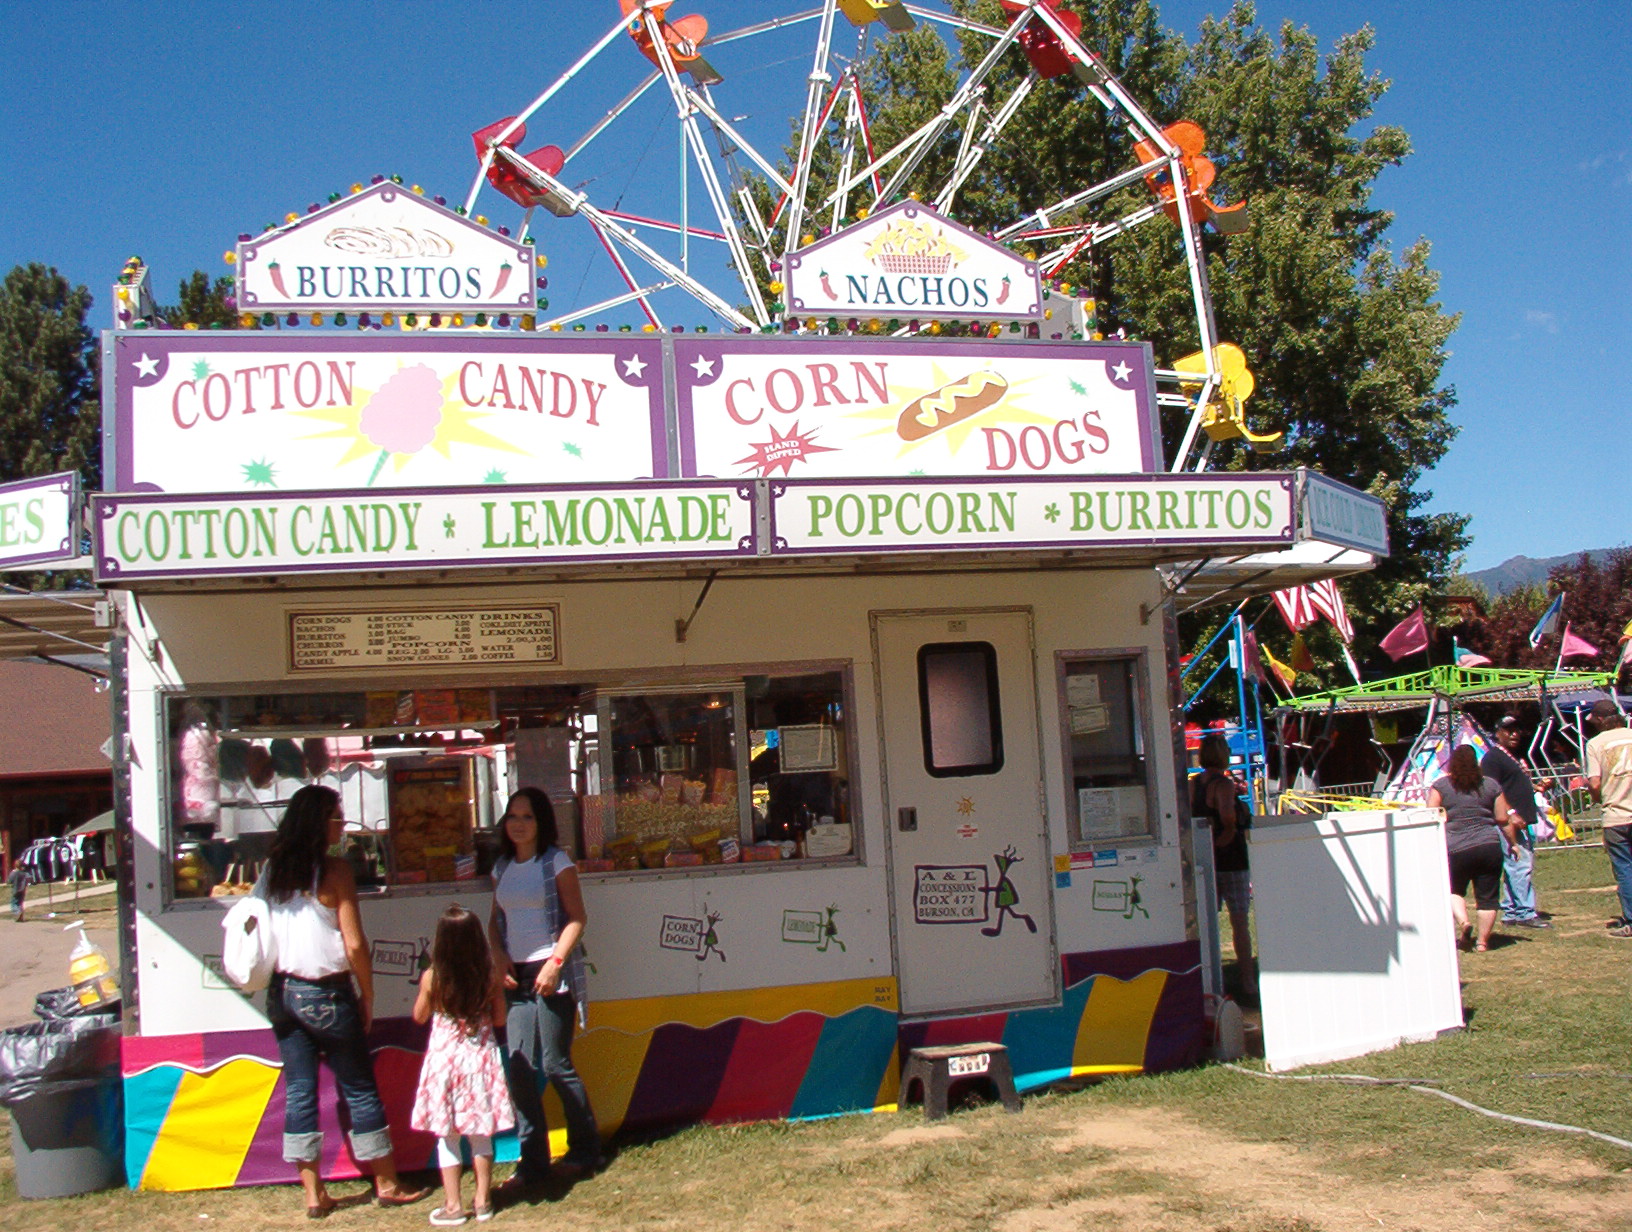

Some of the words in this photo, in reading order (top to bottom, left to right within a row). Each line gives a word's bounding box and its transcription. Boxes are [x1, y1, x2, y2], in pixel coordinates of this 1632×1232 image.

[297, 265, 482, 299] BURRITOS
[846, 274, 989, 307] NACHOS
[172, 360, 356, 430] COTTON
[460, 362, 606, 426] CANDY
[725, 362, 889, 427] CORN
[982, 412, 1110, 470] DOGS
[808, 491, 1017, 537] POPCORN
[1070, 489, 1273, 531] BURRITOS
[117, 507, 278, 562] COTTON
[290, 502, 422, 556] CANDY
[481, 494, 732, 549] LEMONADE
[296, 633, 346, 641] BURRITOS
[480, 628, 551, 636] LEMONADE
[392, 640, 471, 648] POPCORN
[922, 871, 936, 880] A
[943, 871, 956, 880] &
[964, 871, 977, 880] L
[920, 883, 976, 893] CONCESSIONS
[920, 895, 950, 905] BOX
[953, 895, 976, 904] 477
[962, 907, 975, 917] CA
[667, 921, 698, 933] CORN
[665, 933, 695, 946] DOGS
